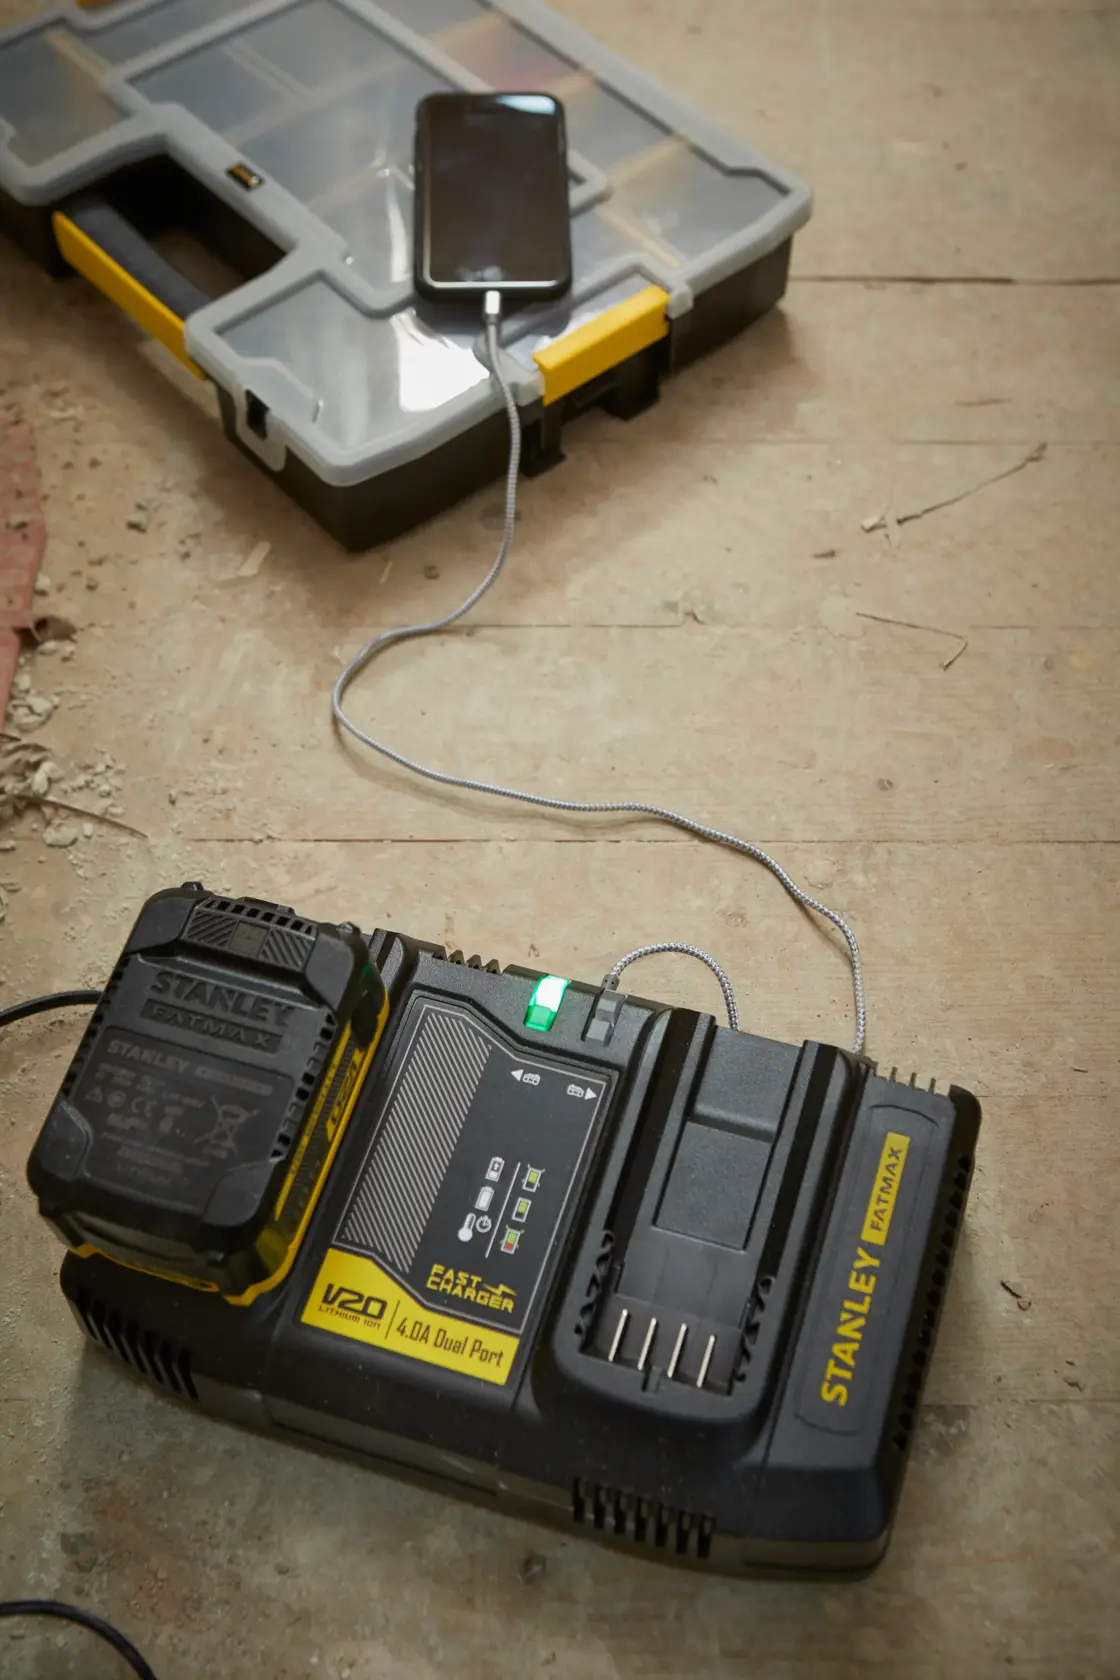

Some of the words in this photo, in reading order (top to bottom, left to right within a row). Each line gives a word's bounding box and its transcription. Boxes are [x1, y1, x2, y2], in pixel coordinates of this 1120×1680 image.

[151, 971, 295, 1026] STANLEY
[152, 1006, 272, 1047] FATMAX
[107, 1039, 191, 1072] STANLEY
[426, 1276, 514, 1313] CHARGER
[430, 1264, 482, 1288] FAST
[820, 1247, 881, 1407] STANLEY
[869, 1146, 902, 1231] FATMAX
[318, 1306, 361, 1324] LITHIUM
[322, 1283, 388, 1320] V20
[396, 1316, 431, 1345] 4.0A
[433, 1327, 468, 1355] Dual
[469, 1339, 503, 1368] Port
